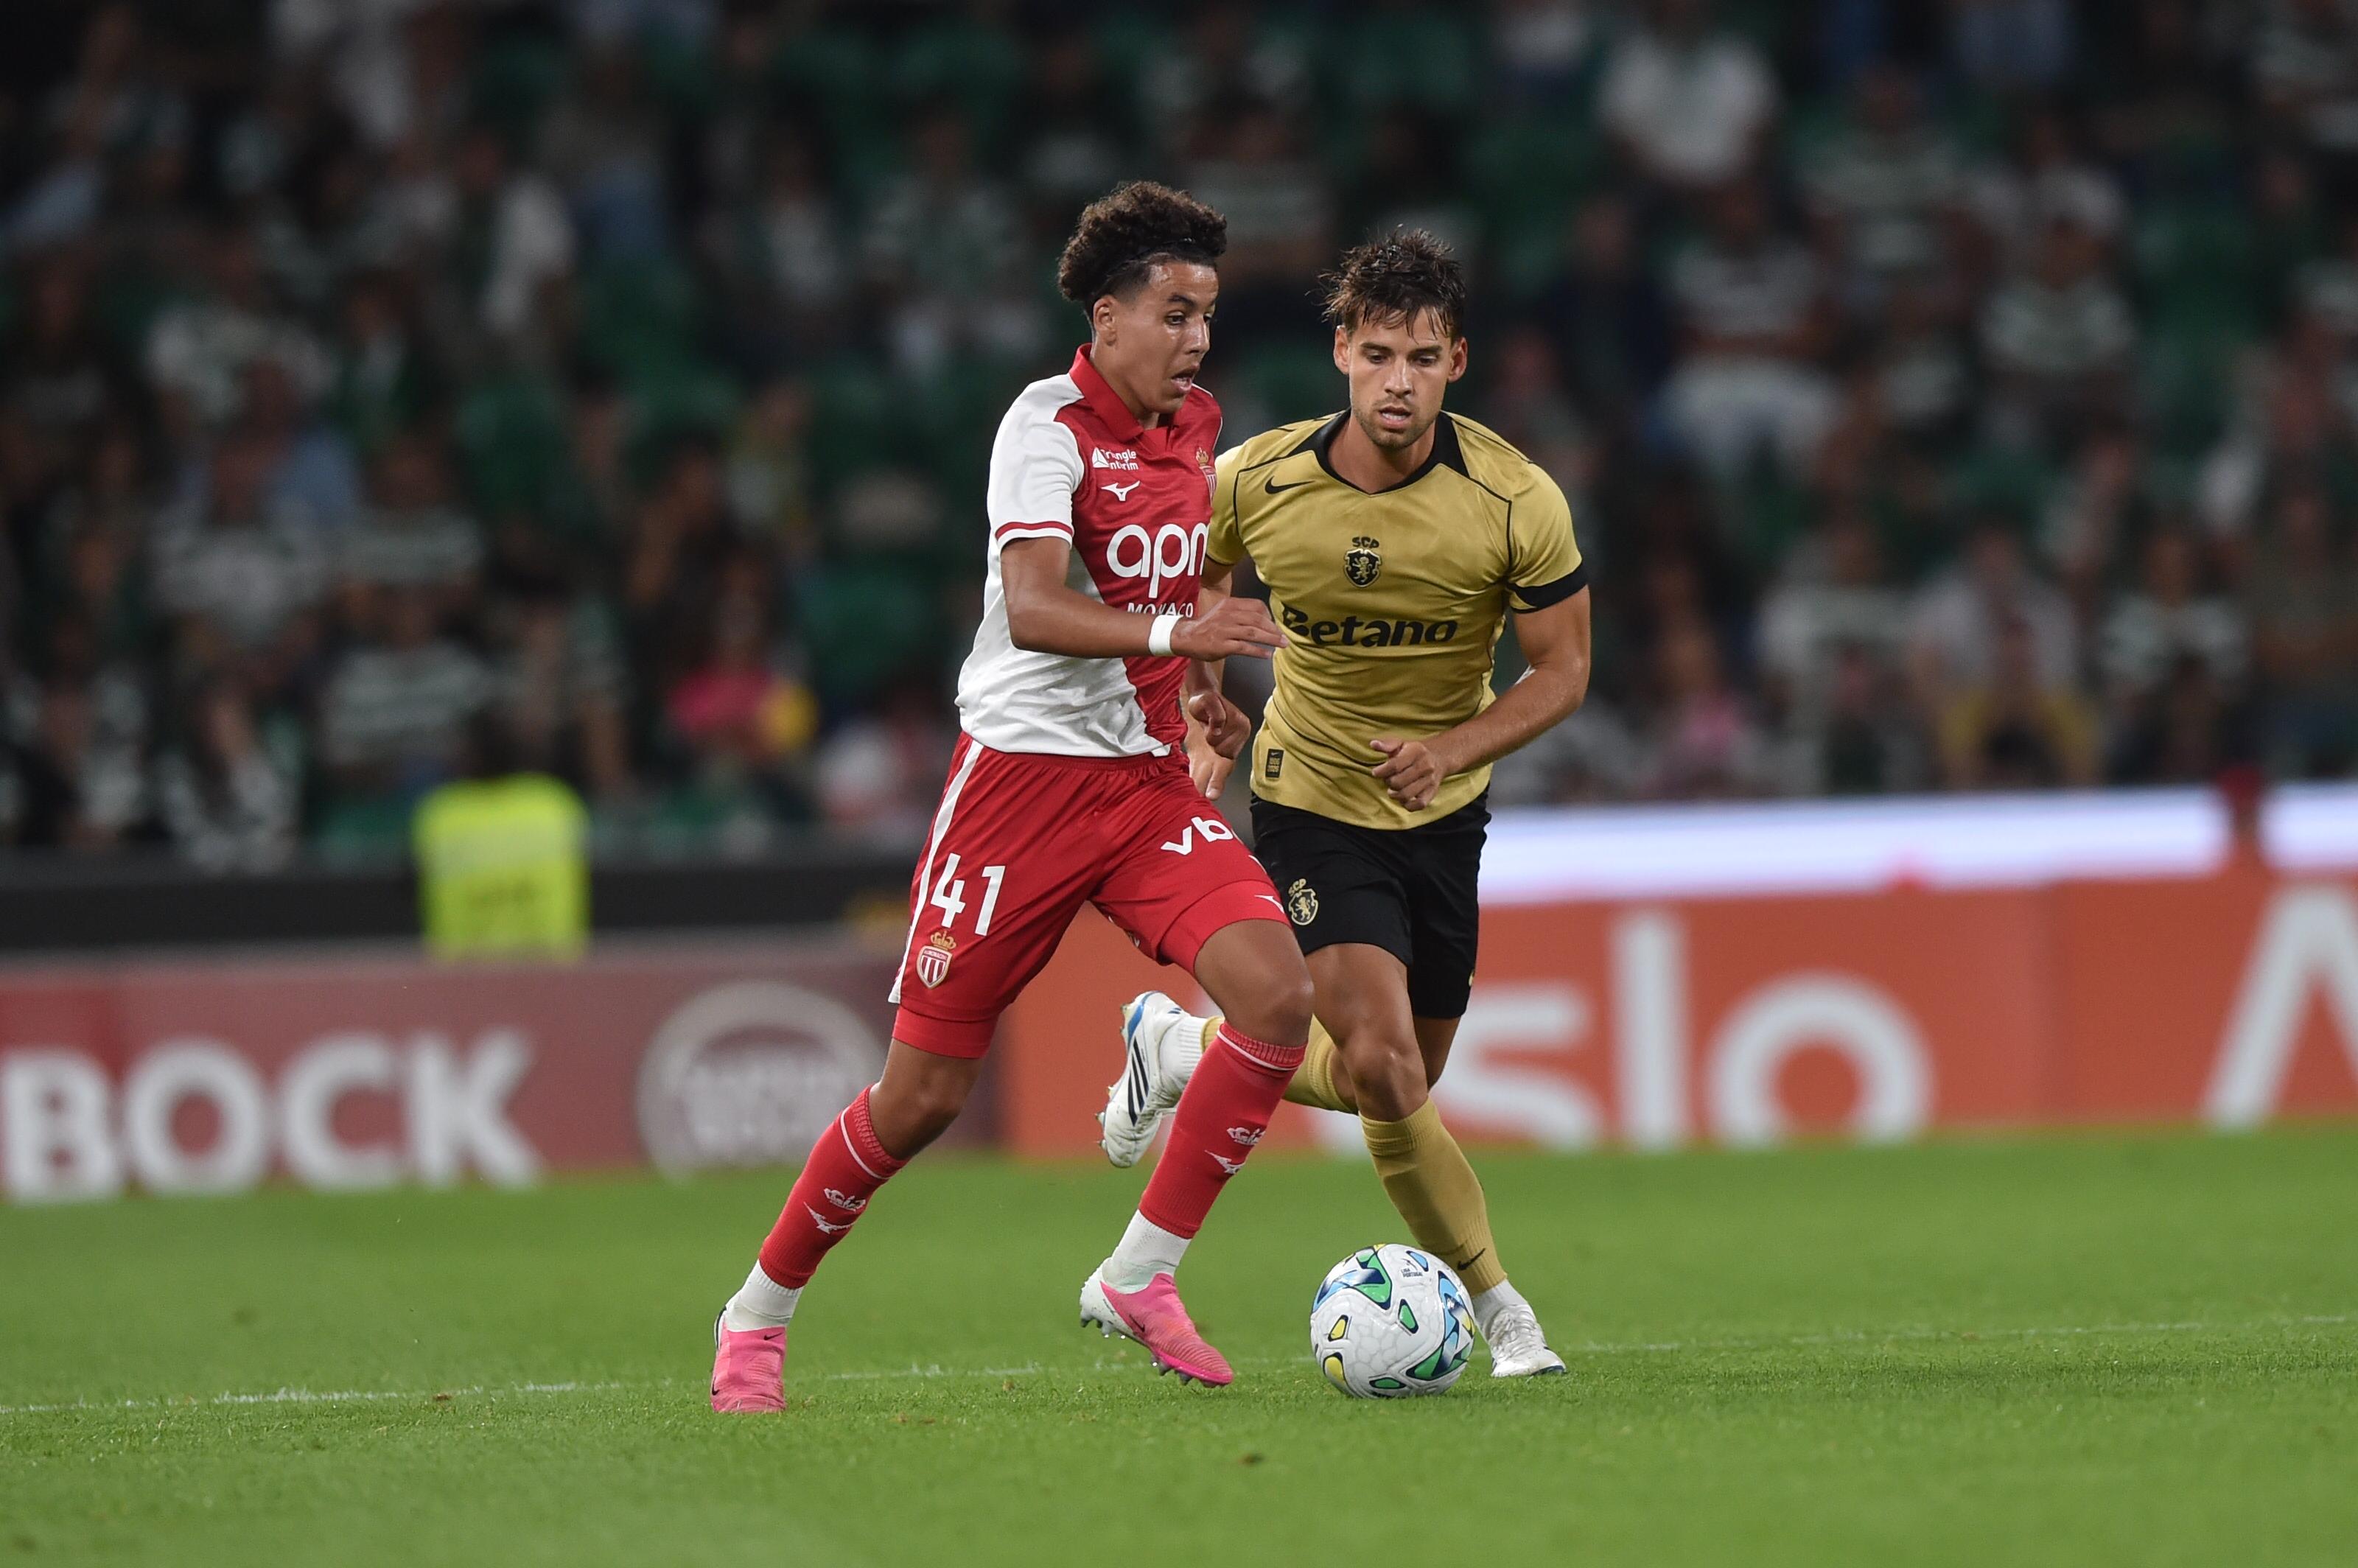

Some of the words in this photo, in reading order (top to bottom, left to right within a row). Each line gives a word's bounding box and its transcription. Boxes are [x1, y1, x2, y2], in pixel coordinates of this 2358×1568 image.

[1351, 536, 1379, 549] SCP
[1281, 603, 1458, 647] Betano
[1160, 814, 1244, 855] vb
[930, 853, 1006, 936] 41
[1288, 878, 1306, 897] SCP
[1308, 910, 1934, 1153] slo
[3, 1030, 544, 1205] BOCK
